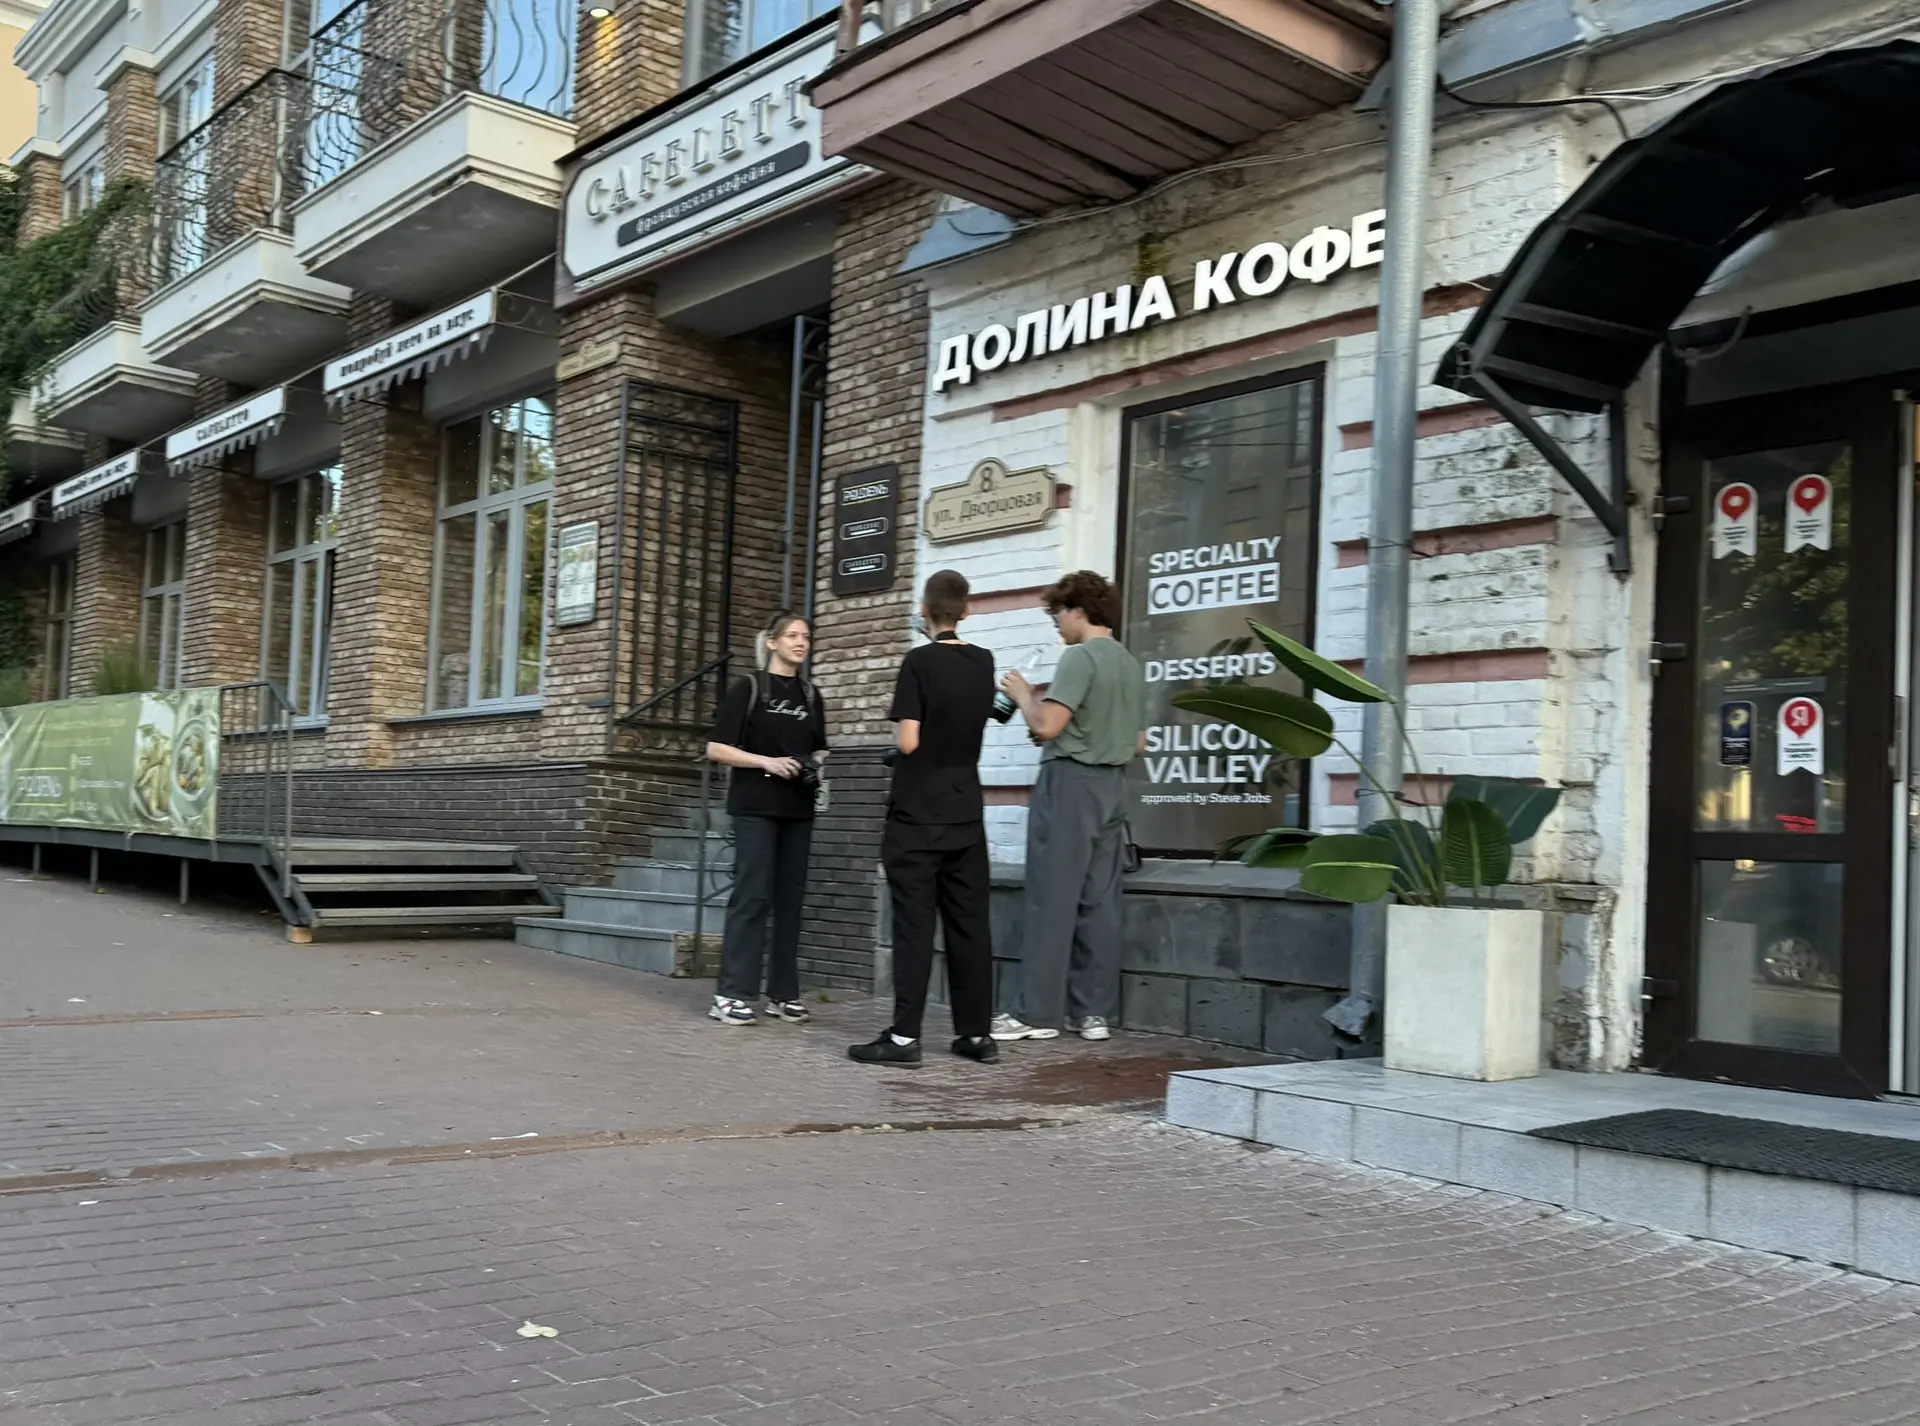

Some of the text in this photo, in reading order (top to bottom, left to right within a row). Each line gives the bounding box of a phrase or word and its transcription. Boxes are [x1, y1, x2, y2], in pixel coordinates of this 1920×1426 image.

[585, 75, 808, 220] CAFELETT
[932, 208, 1386, 392] ДОЛИНА КОФЕ
[980, 466, 993, 493] 8
[958, 491, 1043, 521] Дворцовая
[1149, 536, 1281, 573] SPECIALTY
[1152, 569, 1278, 609] COFFEE
[1145, 652, 1277, 682] DESSERTS
[1144, 755, 1272, 783] VALLEY
[1209, 792, 1242, 803] Steve
